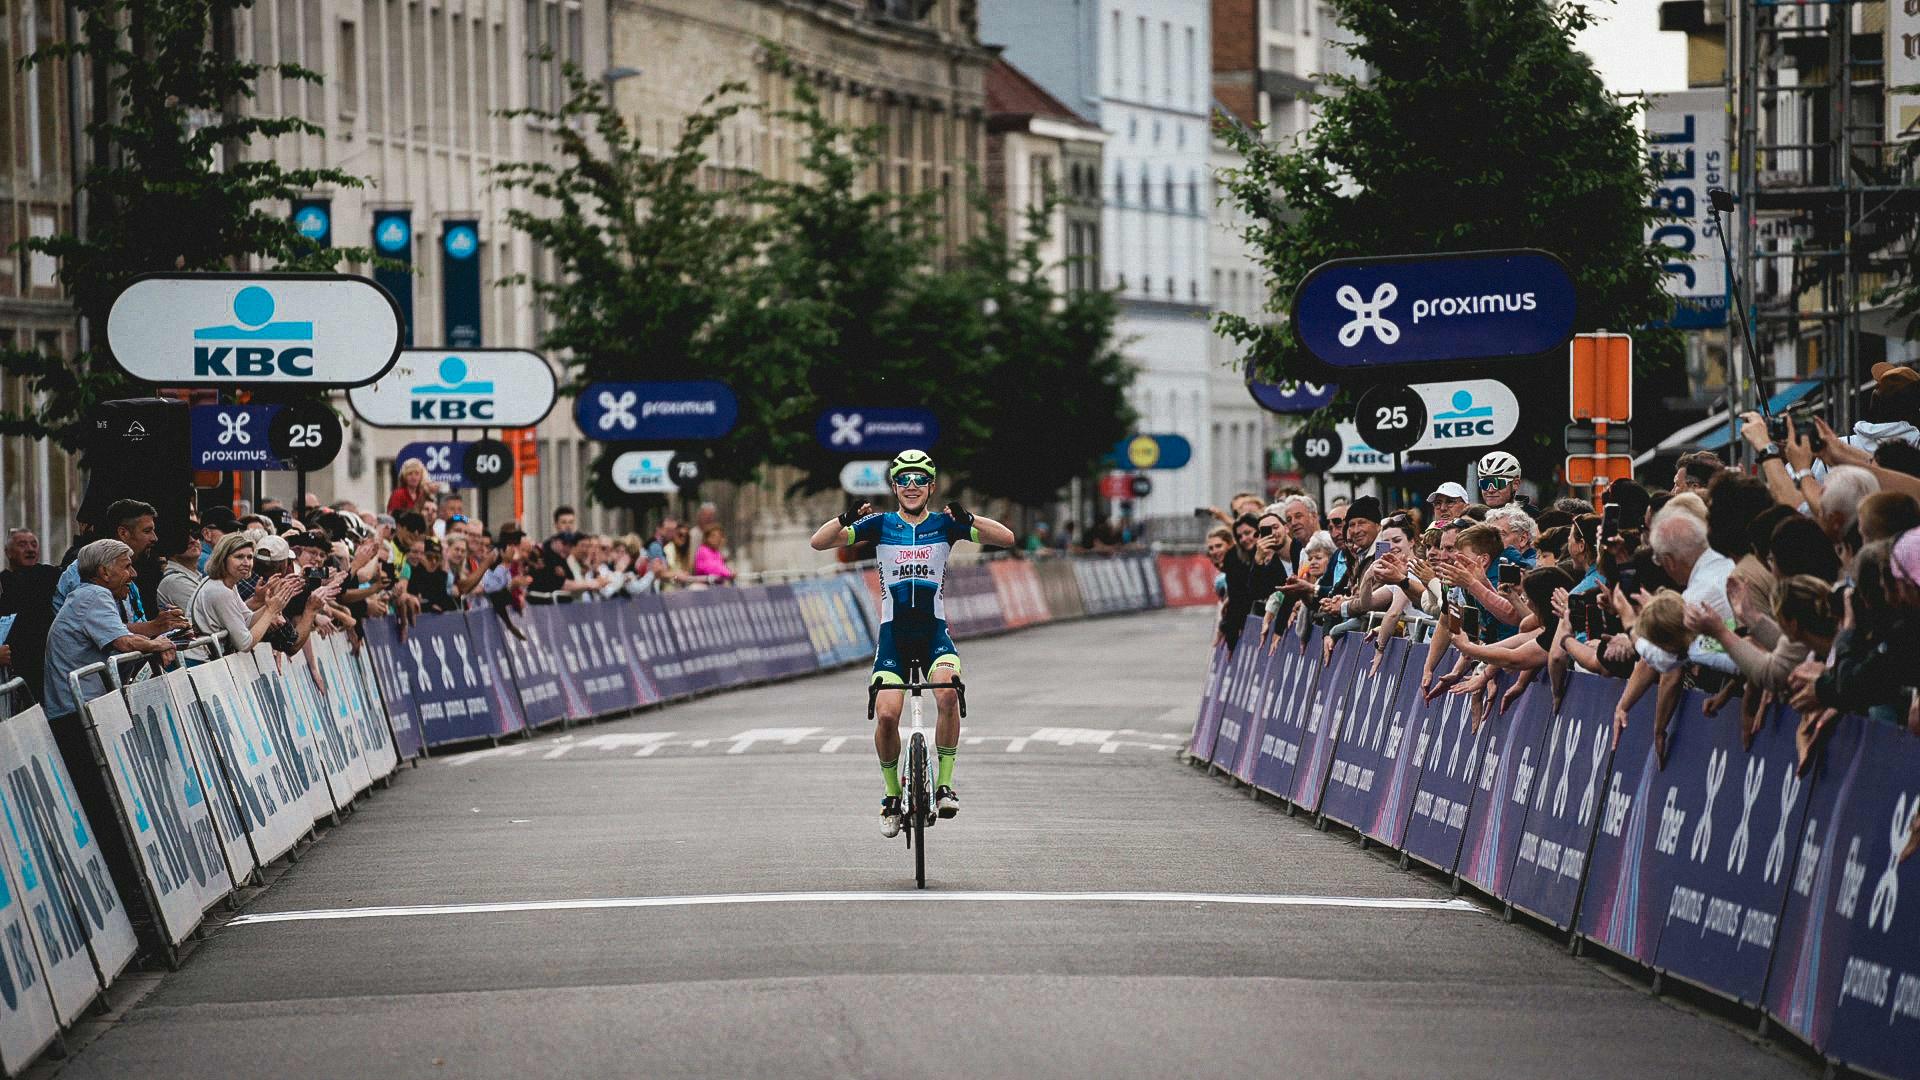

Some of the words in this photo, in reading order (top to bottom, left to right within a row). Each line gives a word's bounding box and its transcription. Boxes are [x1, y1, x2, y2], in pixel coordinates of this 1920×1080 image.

[1651, 115, 1696, 289] JOBEL
[1413, 291, 1536, 323] proximus
[194, 347, 314, 377] KBC
[410, 400, 495, 420] KBC
[1375, 406, 1409, 430] 25
[288, 424, 323, 447] 25
[1433, 419, 1494, 439] KBC
[202, 449, 267, 464] proximus
[1305, 438, 1330, 457] 50
[476, 454, 501, 473] 50
[677, 461, 698, 478] 75
[1347, 454, 1391, 465] KBC
[121, 704, 206, 888] KBC
[1655, 786, 1686, 856] fiber
